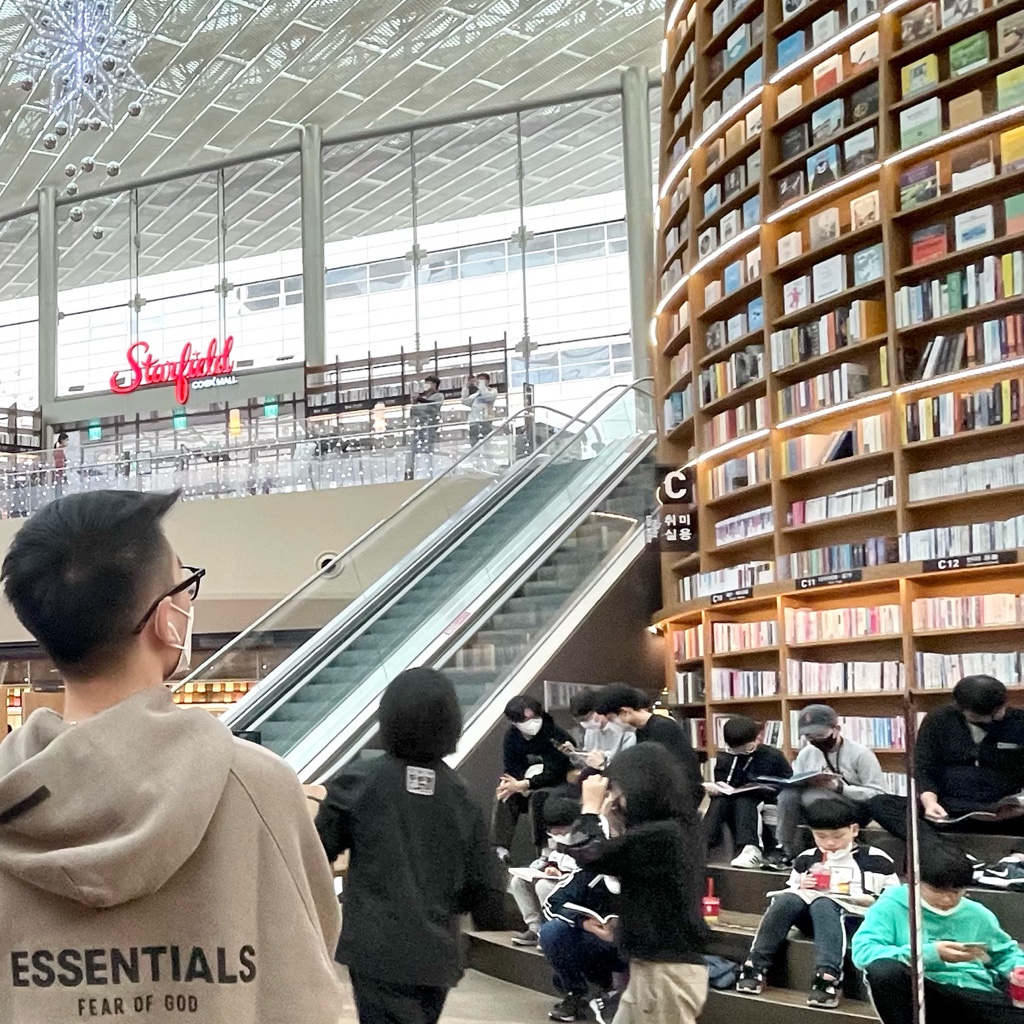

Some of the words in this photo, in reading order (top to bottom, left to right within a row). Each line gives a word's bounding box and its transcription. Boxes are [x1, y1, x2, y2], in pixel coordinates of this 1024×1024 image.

[109, 335, 234, 405] Starfield
[664, 470, 687, 499] C
[664, 513, 691, 527] 취미
[664, 528, 692, 541] 실용
[938, 559, 960, 570] C12
[801, 579, 816, 588] C11
[10, 945, 257, 987] ESSENTIALS
[78, 998, 124, 1016] FEAR
[134, 994, 154, 1013] OF
[164, 994, 198, 1013] GOD
